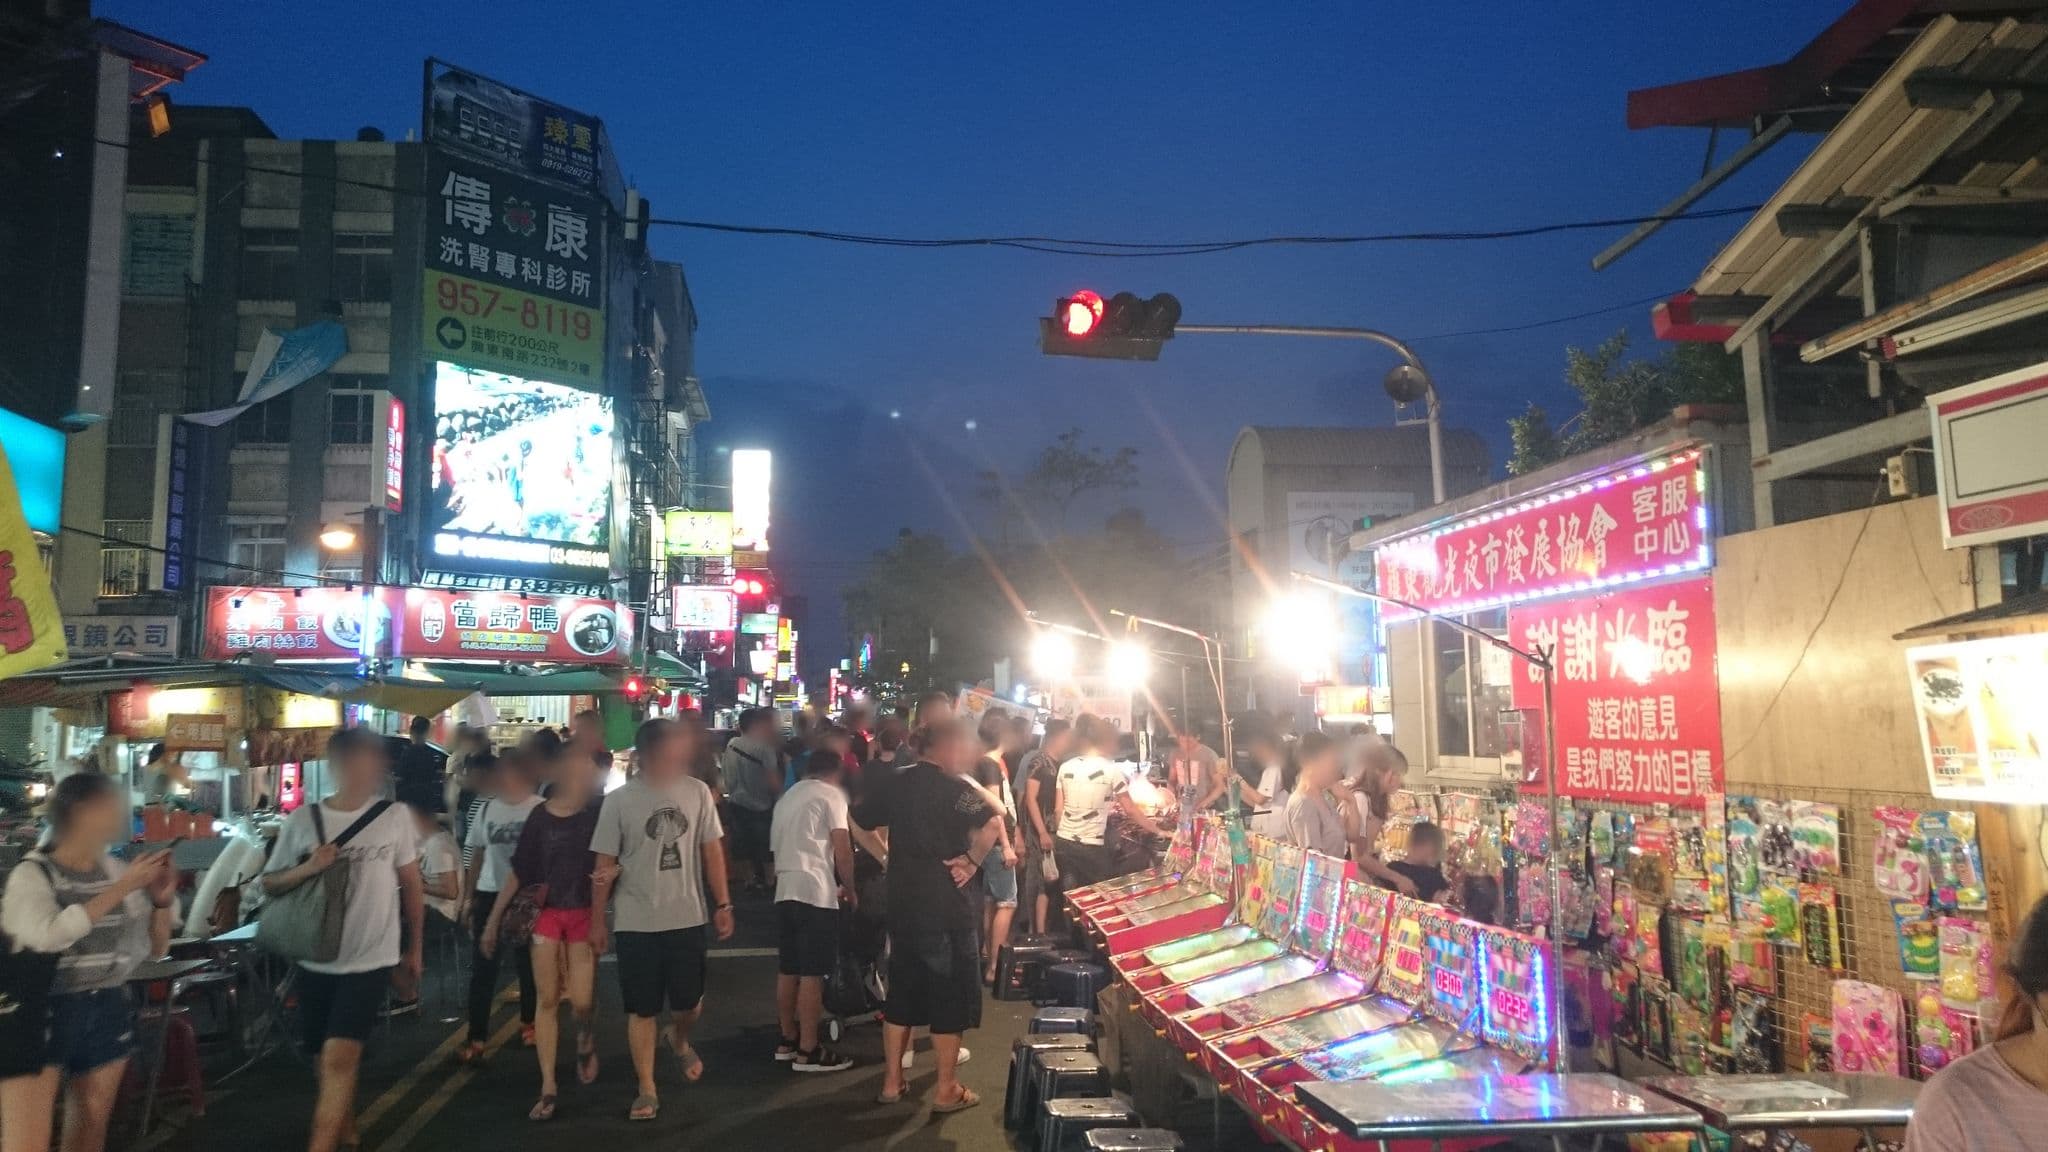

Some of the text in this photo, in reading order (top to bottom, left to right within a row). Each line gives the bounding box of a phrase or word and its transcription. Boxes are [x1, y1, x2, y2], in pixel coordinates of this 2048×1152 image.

[439, 235, 592, 298] 洗腎專科診所
[437, 276, 592, 341] 957-8119
[1632, 474, 1689, 525] 客服
[1634, 518, 1690, 563] 中心
[1525, 599, 1693, 686] 謝謝光臨
[1587, 695, 1679, 742] 遊客的意見
[1566, 746, 1714, 797] 是我們努力的目標
[1435, 968, 1463, 999] 0300
[1498, 990, 1529, 1022] 0232
